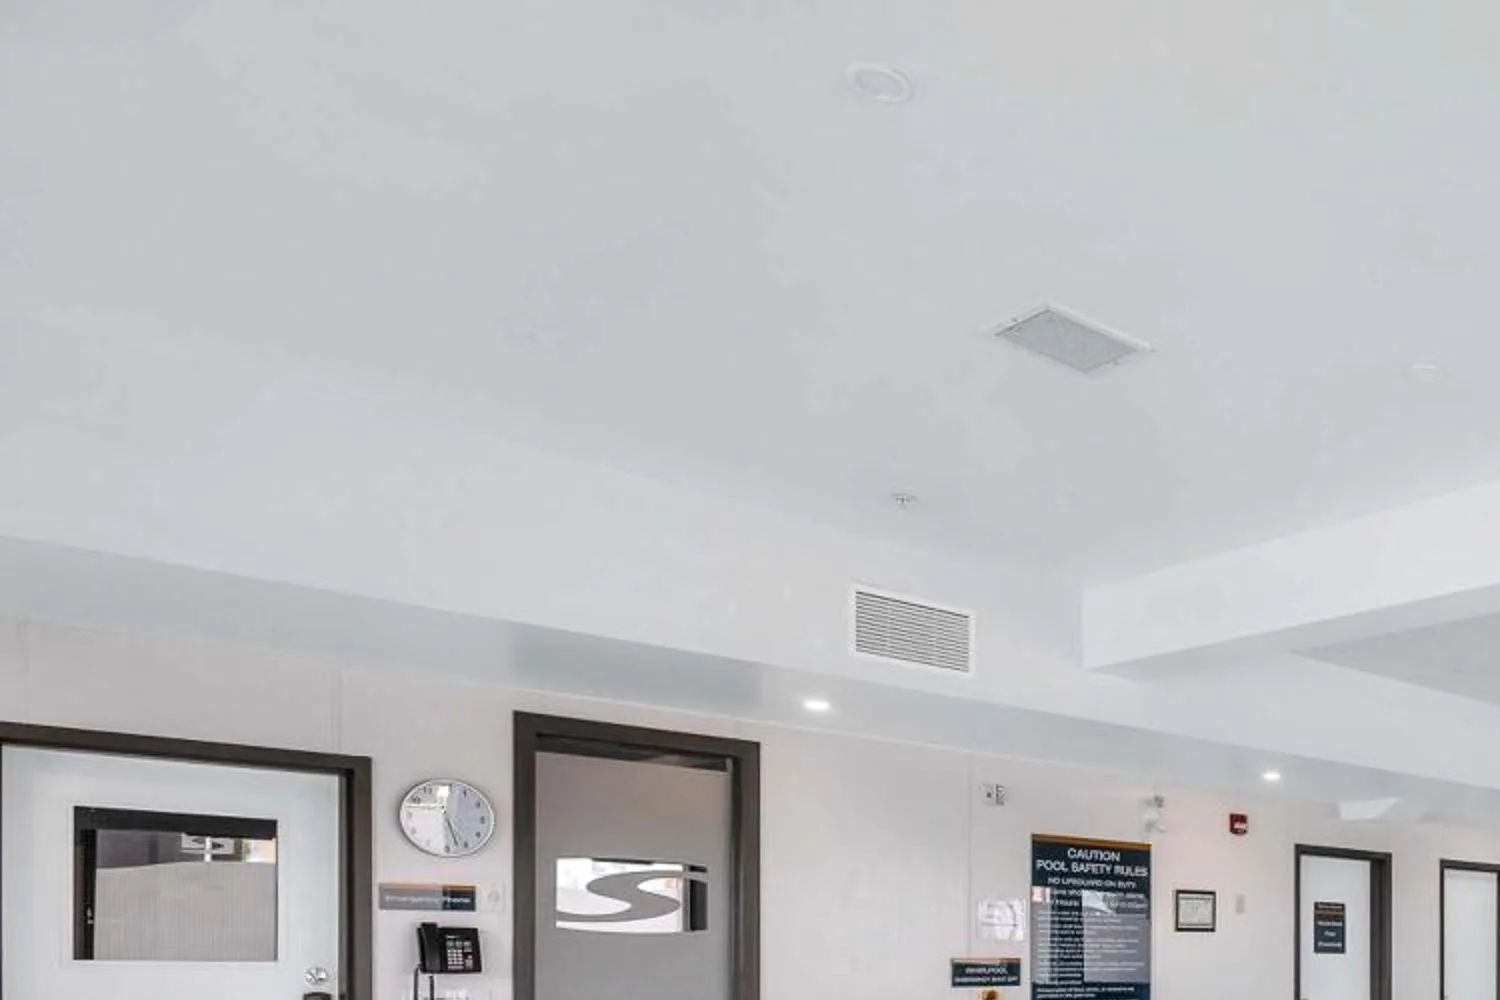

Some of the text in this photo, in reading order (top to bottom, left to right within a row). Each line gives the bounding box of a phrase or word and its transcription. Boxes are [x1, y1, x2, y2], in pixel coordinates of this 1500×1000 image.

[1067, 848, 1121, 861] CAUTION
[1037, 859, 1149, 877] POOL SAFETY RULES
